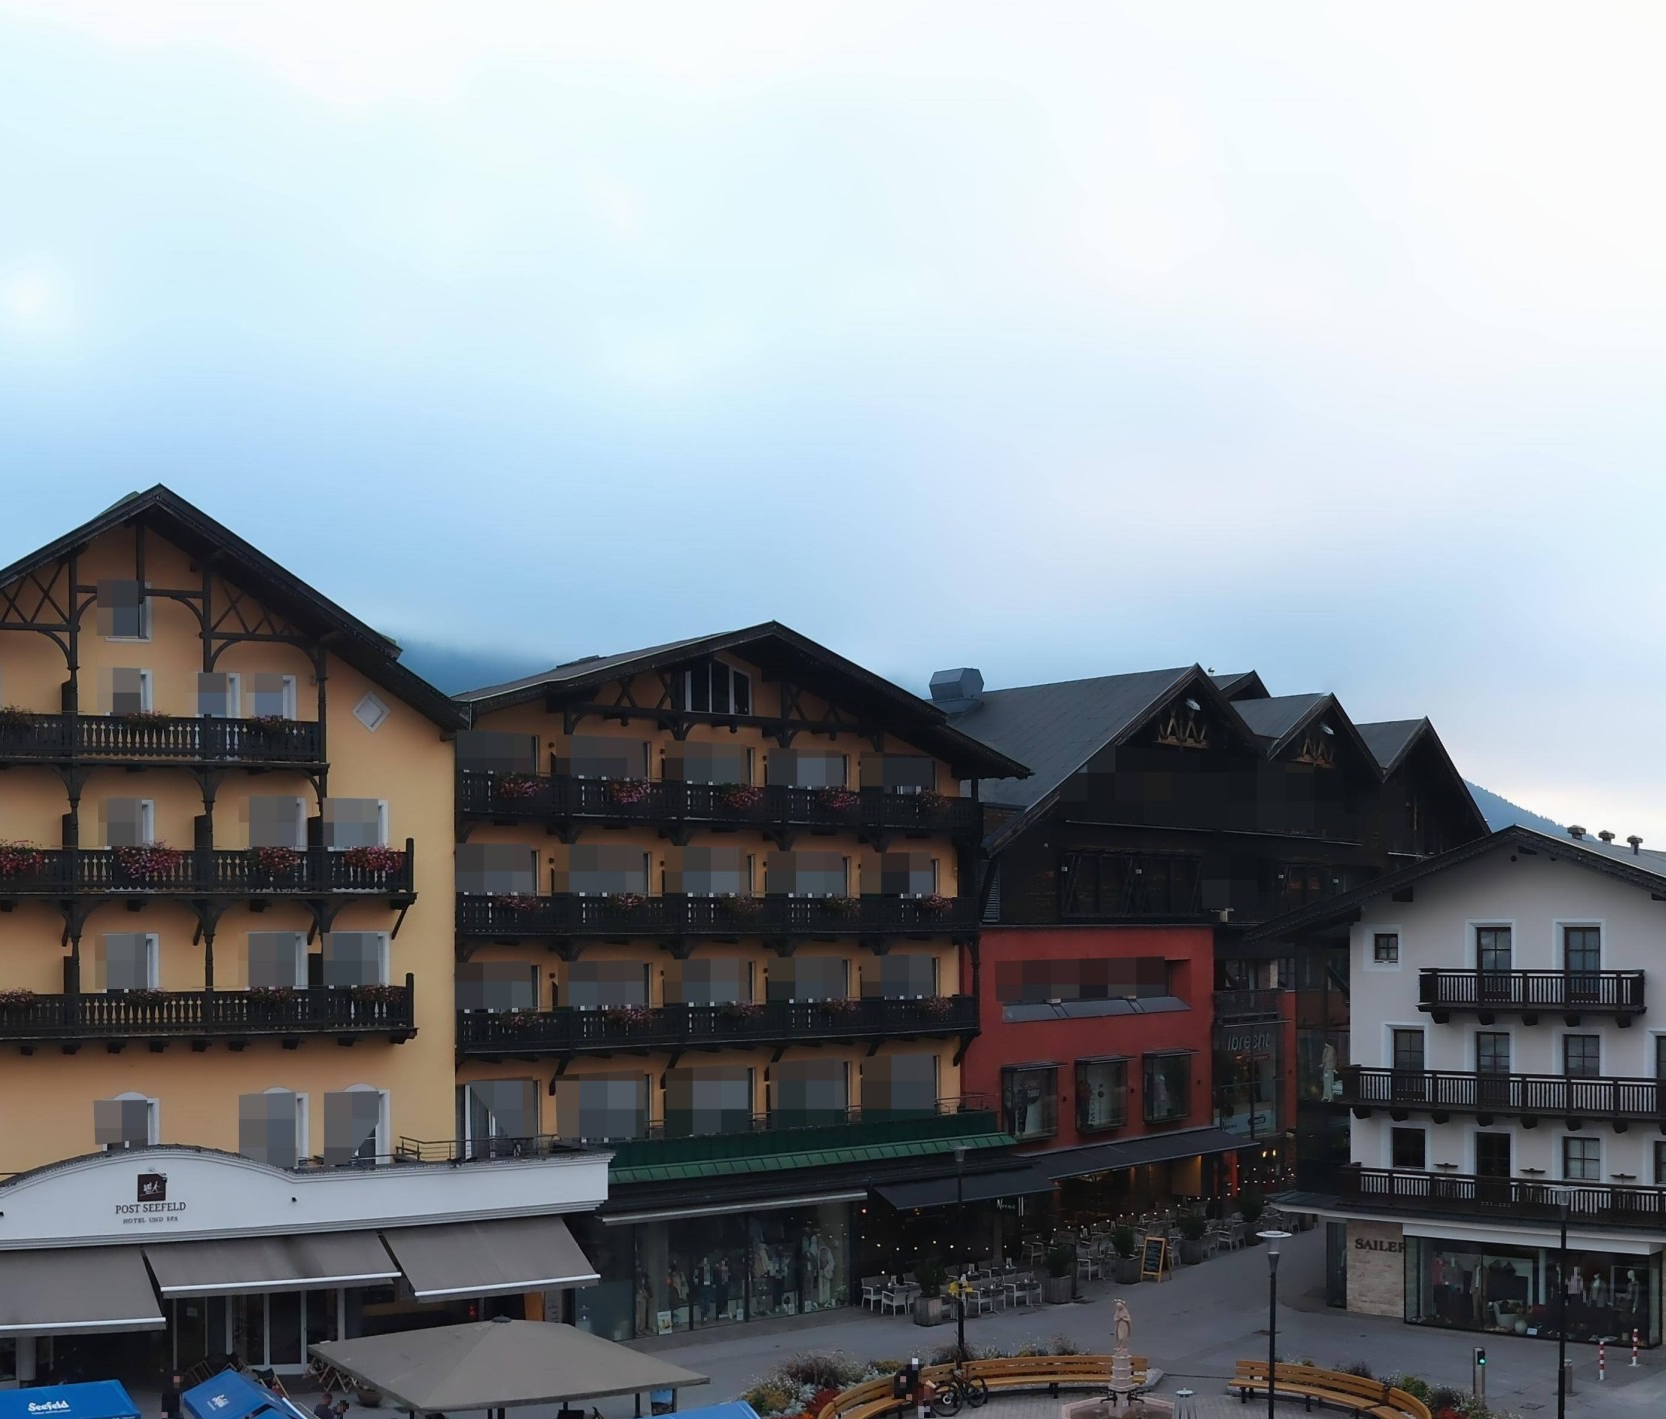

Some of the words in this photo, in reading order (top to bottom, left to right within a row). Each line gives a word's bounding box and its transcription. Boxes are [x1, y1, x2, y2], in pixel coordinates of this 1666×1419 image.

[115, 1203, 140, 1214] POST
[143, 1201, 187, 1213] SEEFELD
[123, 1216, 145, 1224] HOTEL
[28, 1400, 70, 1412] Seefeld
